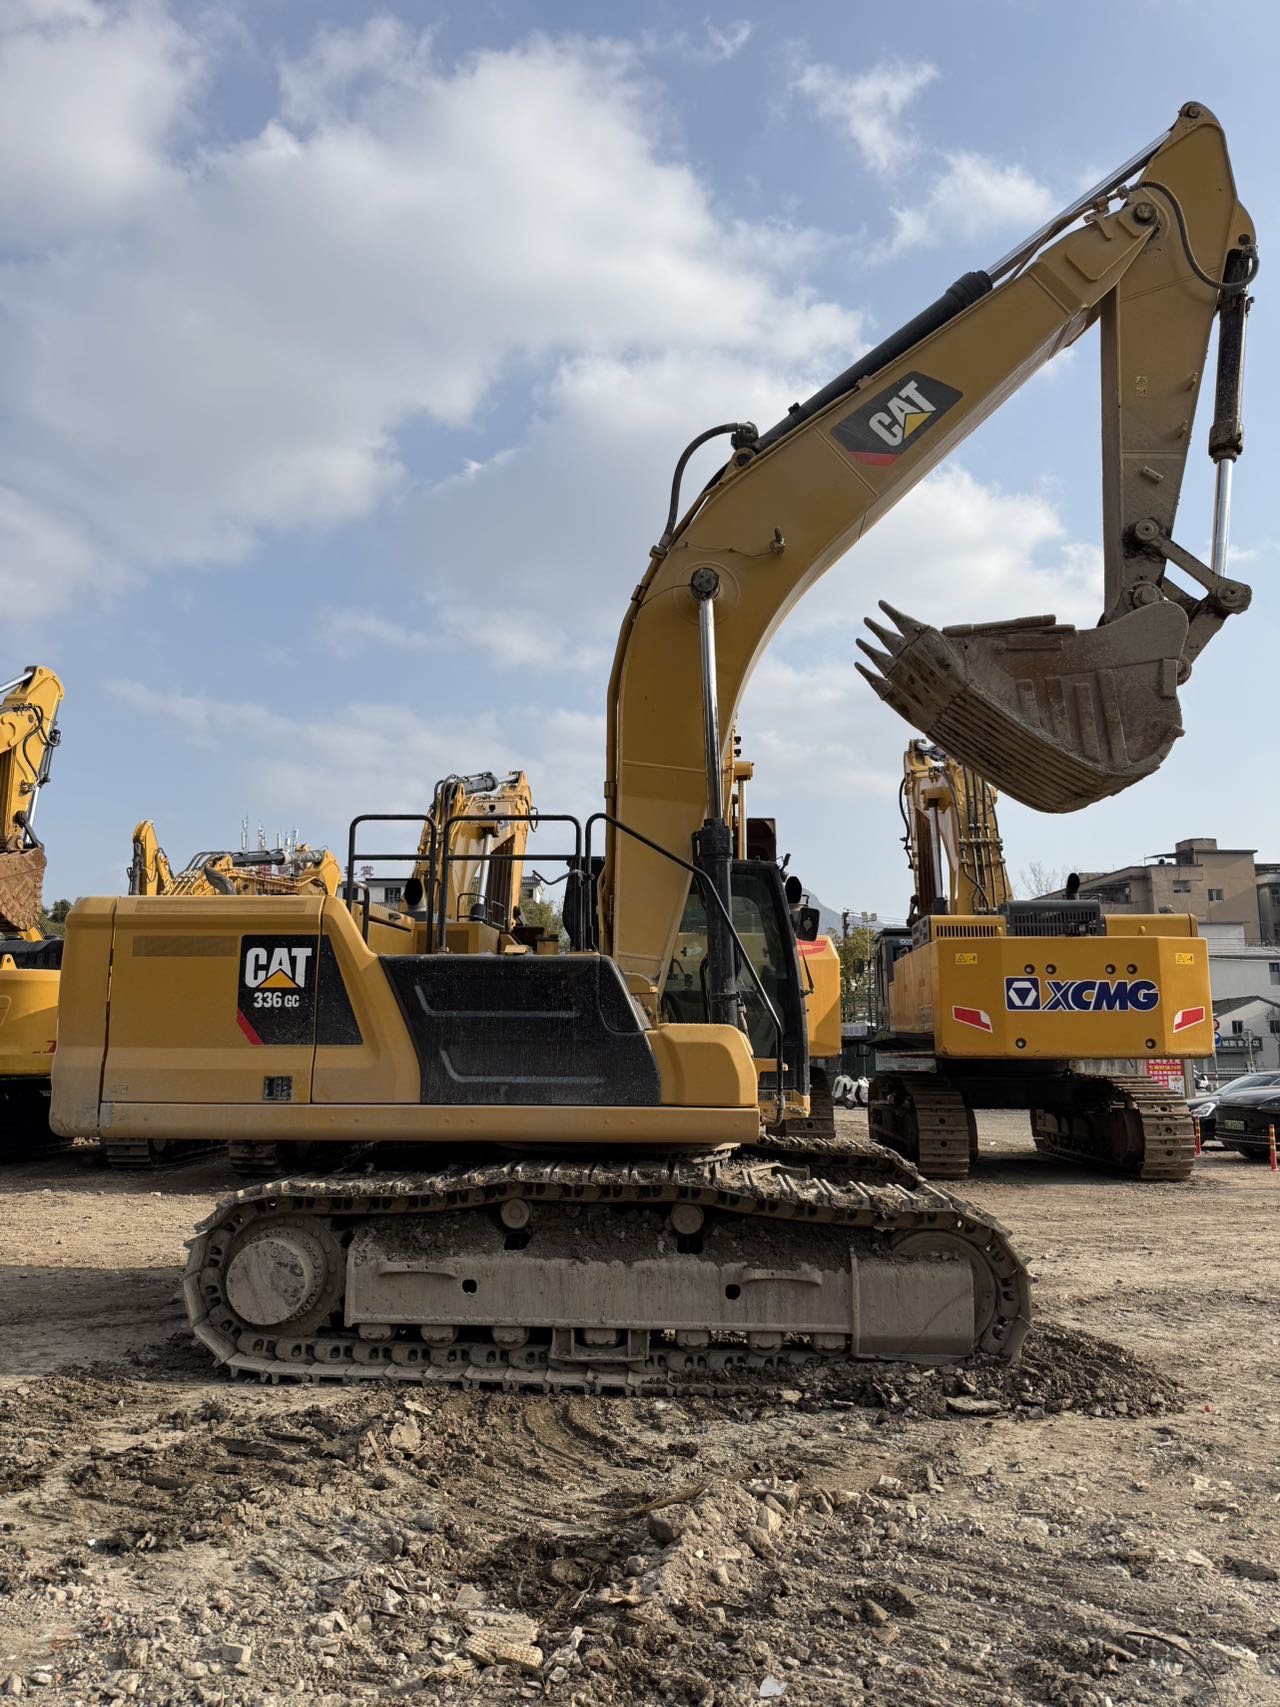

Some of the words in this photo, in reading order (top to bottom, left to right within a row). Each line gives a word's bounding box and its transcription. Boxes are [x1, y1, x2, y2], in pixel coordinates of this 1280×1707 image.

[869, 380, 937, 447] CAT
[244, 947, 313, 989] CAT
[253, 992, 282, 1008] 336
[284, 994, 300, 1008] GC
[1041, 979, 1159, 1011] XCMG
